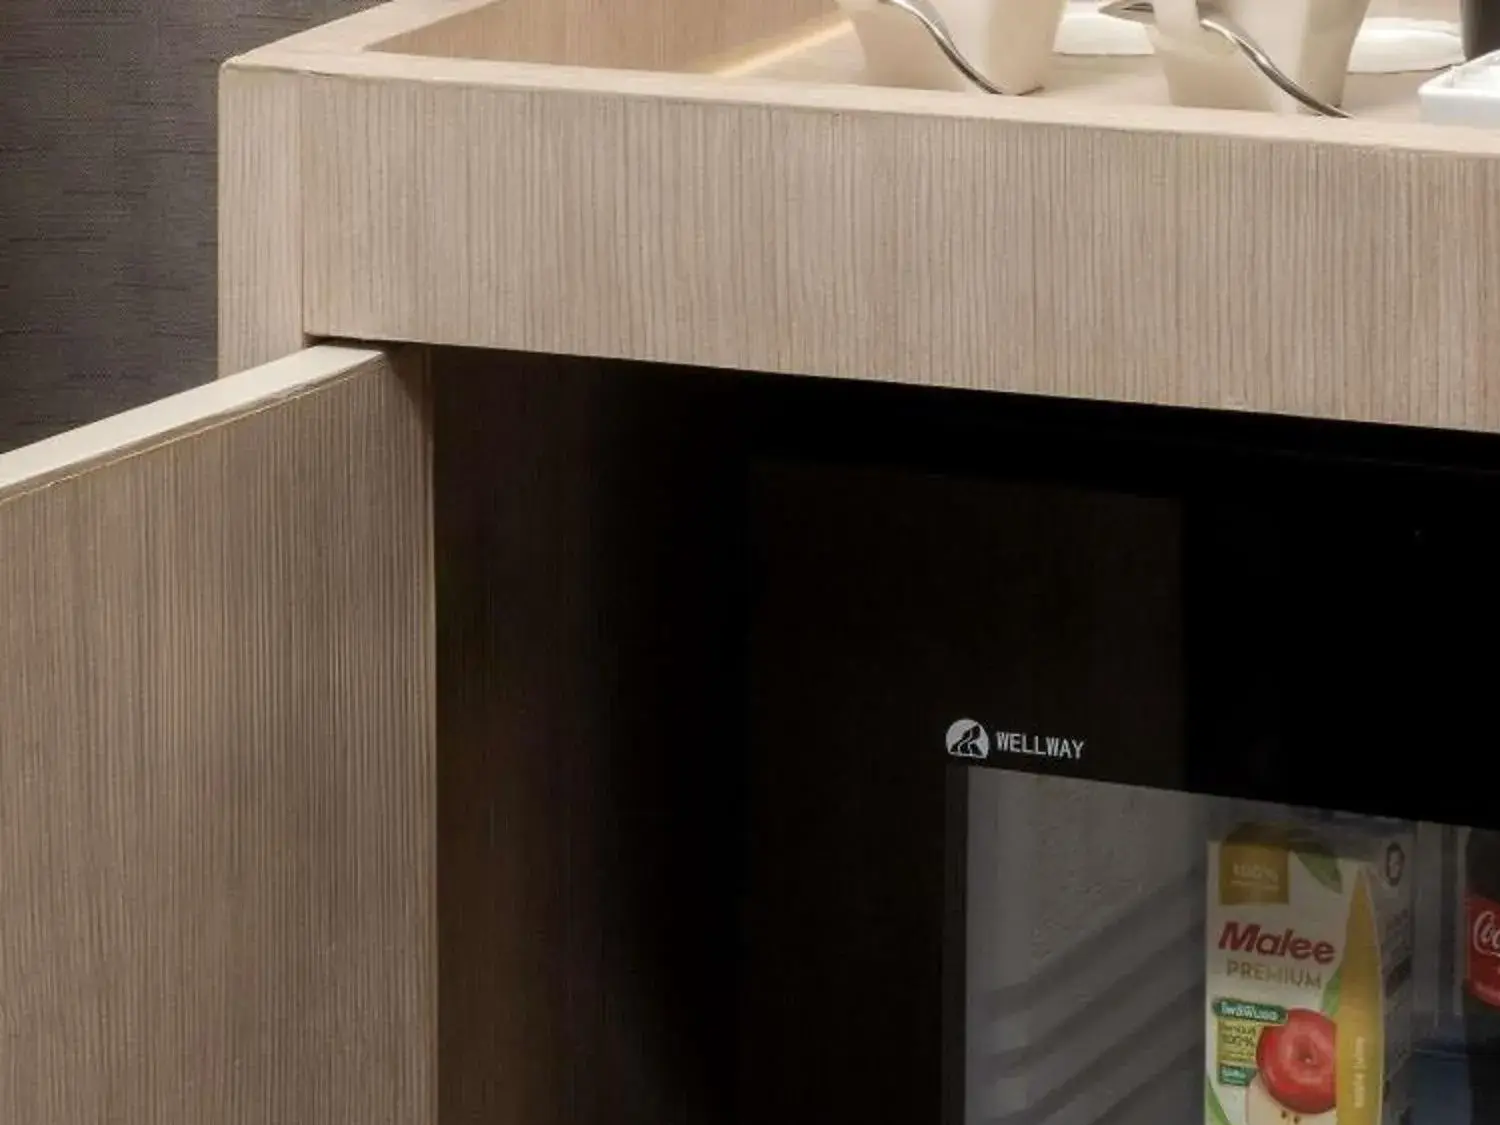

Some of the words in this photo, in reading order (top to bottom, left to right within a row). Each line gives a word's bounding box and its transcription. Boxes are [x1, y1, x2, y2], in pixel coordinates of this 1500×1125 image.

[996, 731, 1084, 759] WELLWAY
[1218, 921, 1336, 965] Malee
[1226, 960, 1323, 990] PREMIUM
